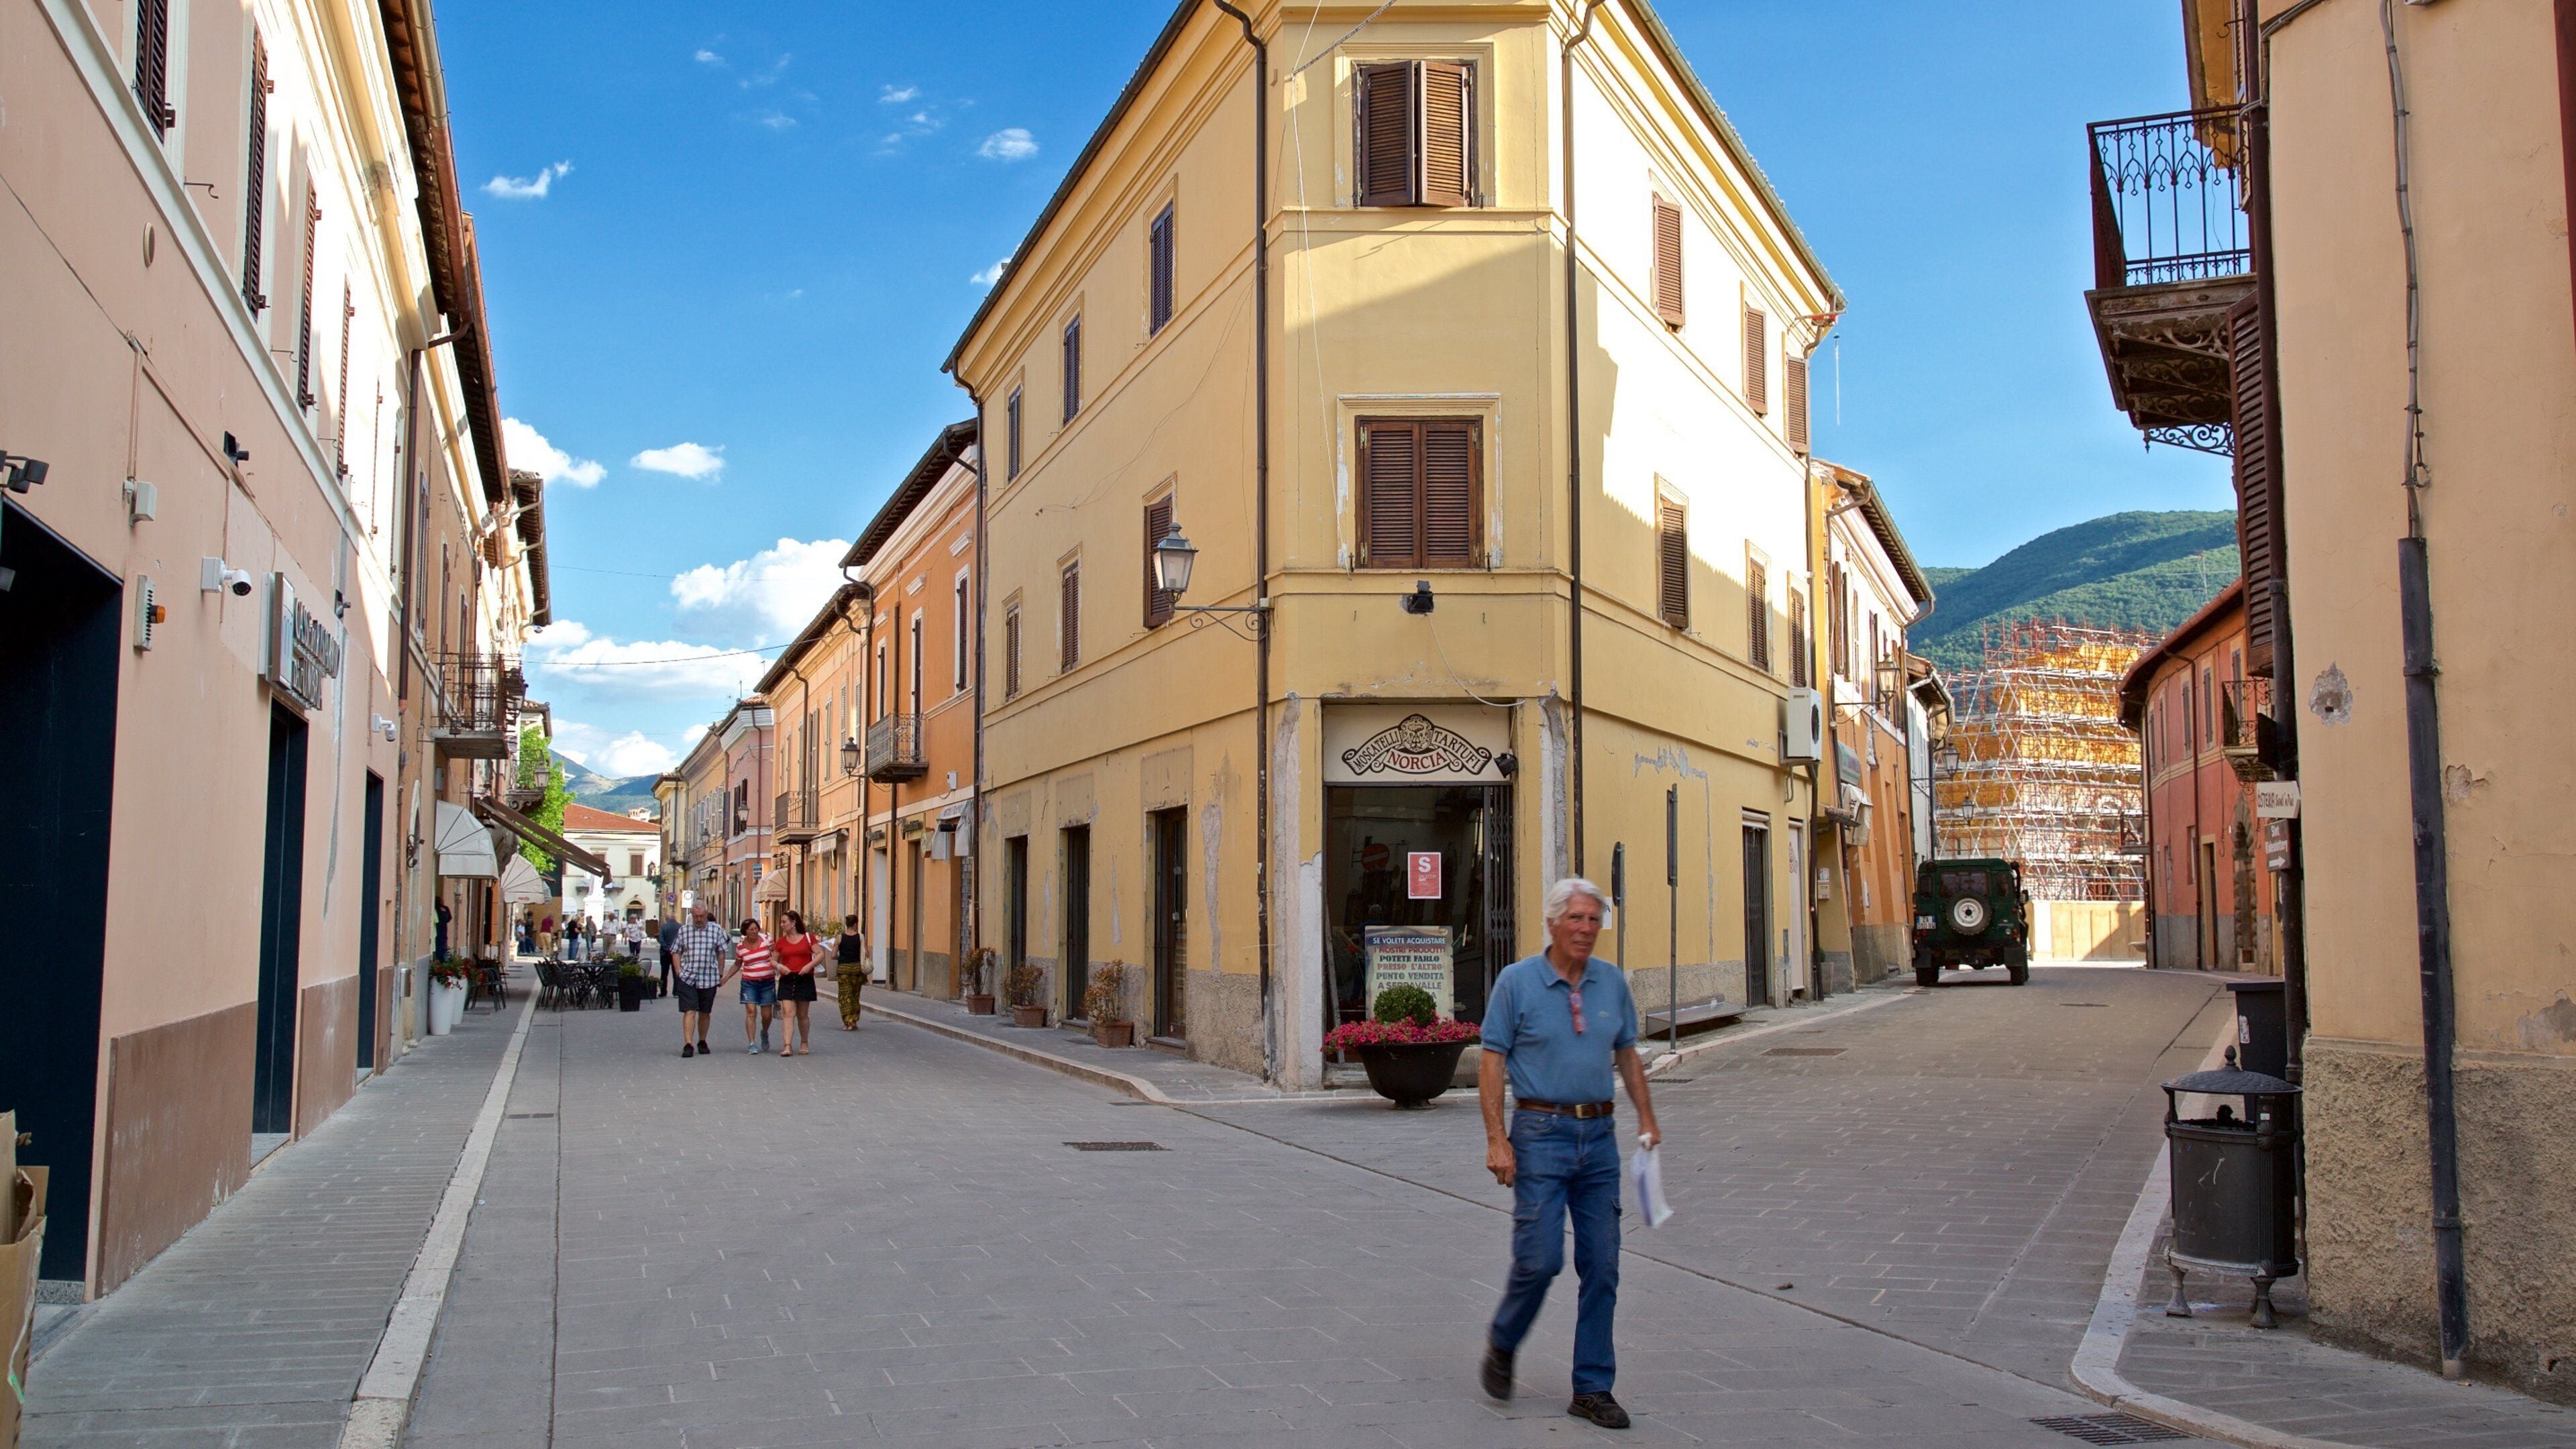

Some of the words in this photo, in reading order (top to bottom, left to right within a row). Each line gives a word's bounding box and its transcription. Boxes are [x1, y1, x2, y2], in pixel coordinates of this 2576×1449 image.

[1354, 731, 1399, 770] MOSCATELLI
[1433, 731, 1481, 770] TARTUFI
[1387, 751, 1448, 769] NORCIA
[1418, 856, 1431, 873] S
